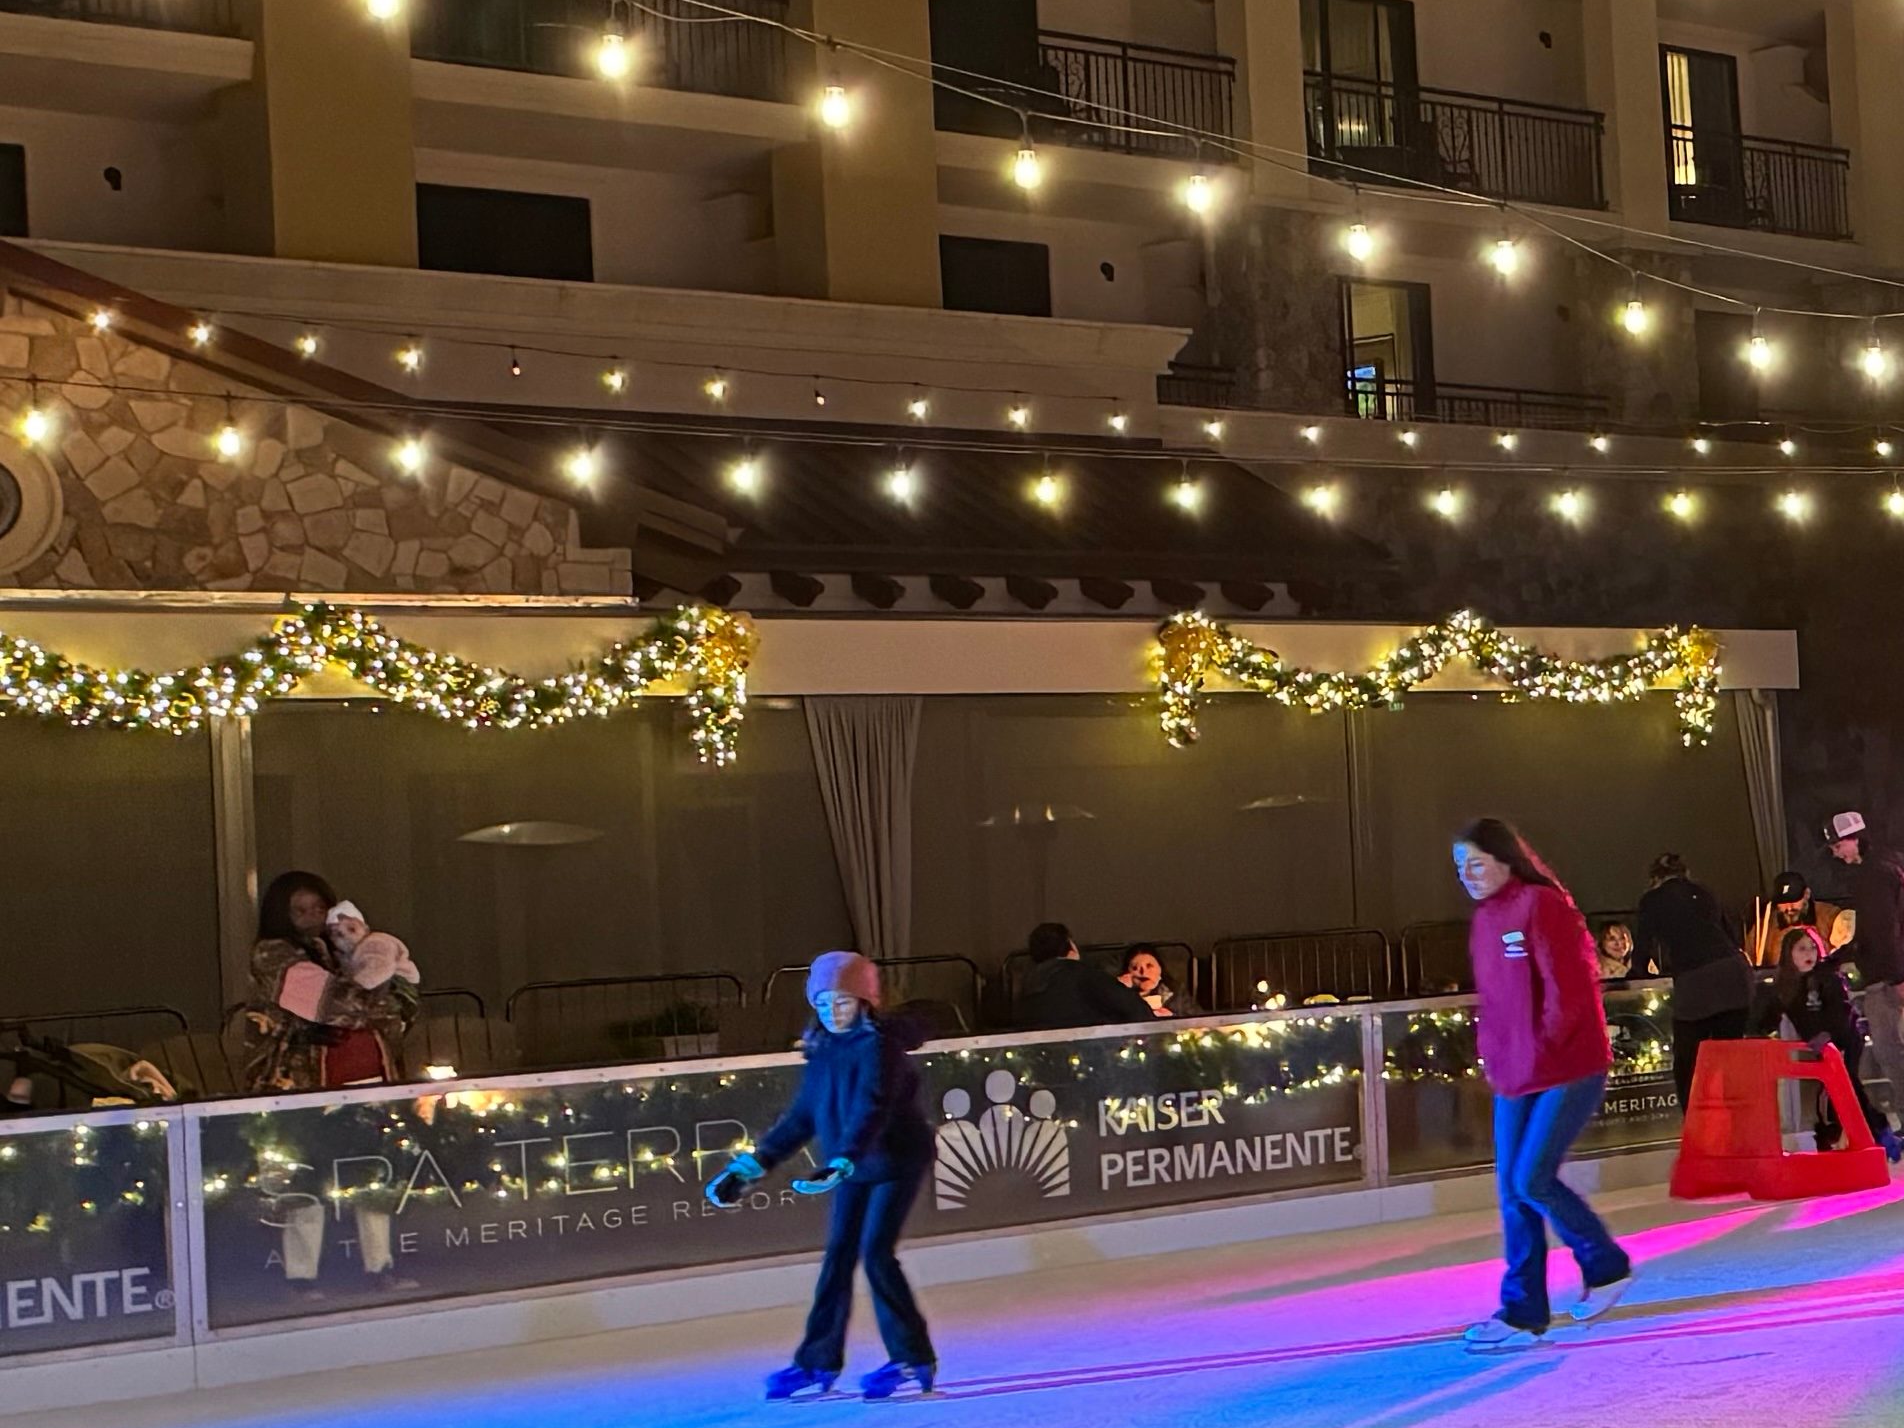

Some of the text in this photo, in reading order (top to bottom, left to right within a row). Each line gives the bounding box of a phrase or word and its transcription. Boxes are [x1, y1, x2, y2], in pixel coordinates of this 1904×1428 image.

[1098, 1088, 1226, 1138] KAISER
[258, 1149, 463, 1229] SPA
[337, 1231, 420, 1260] TE
[445, 1204, 650, 1249] MERITAGE
